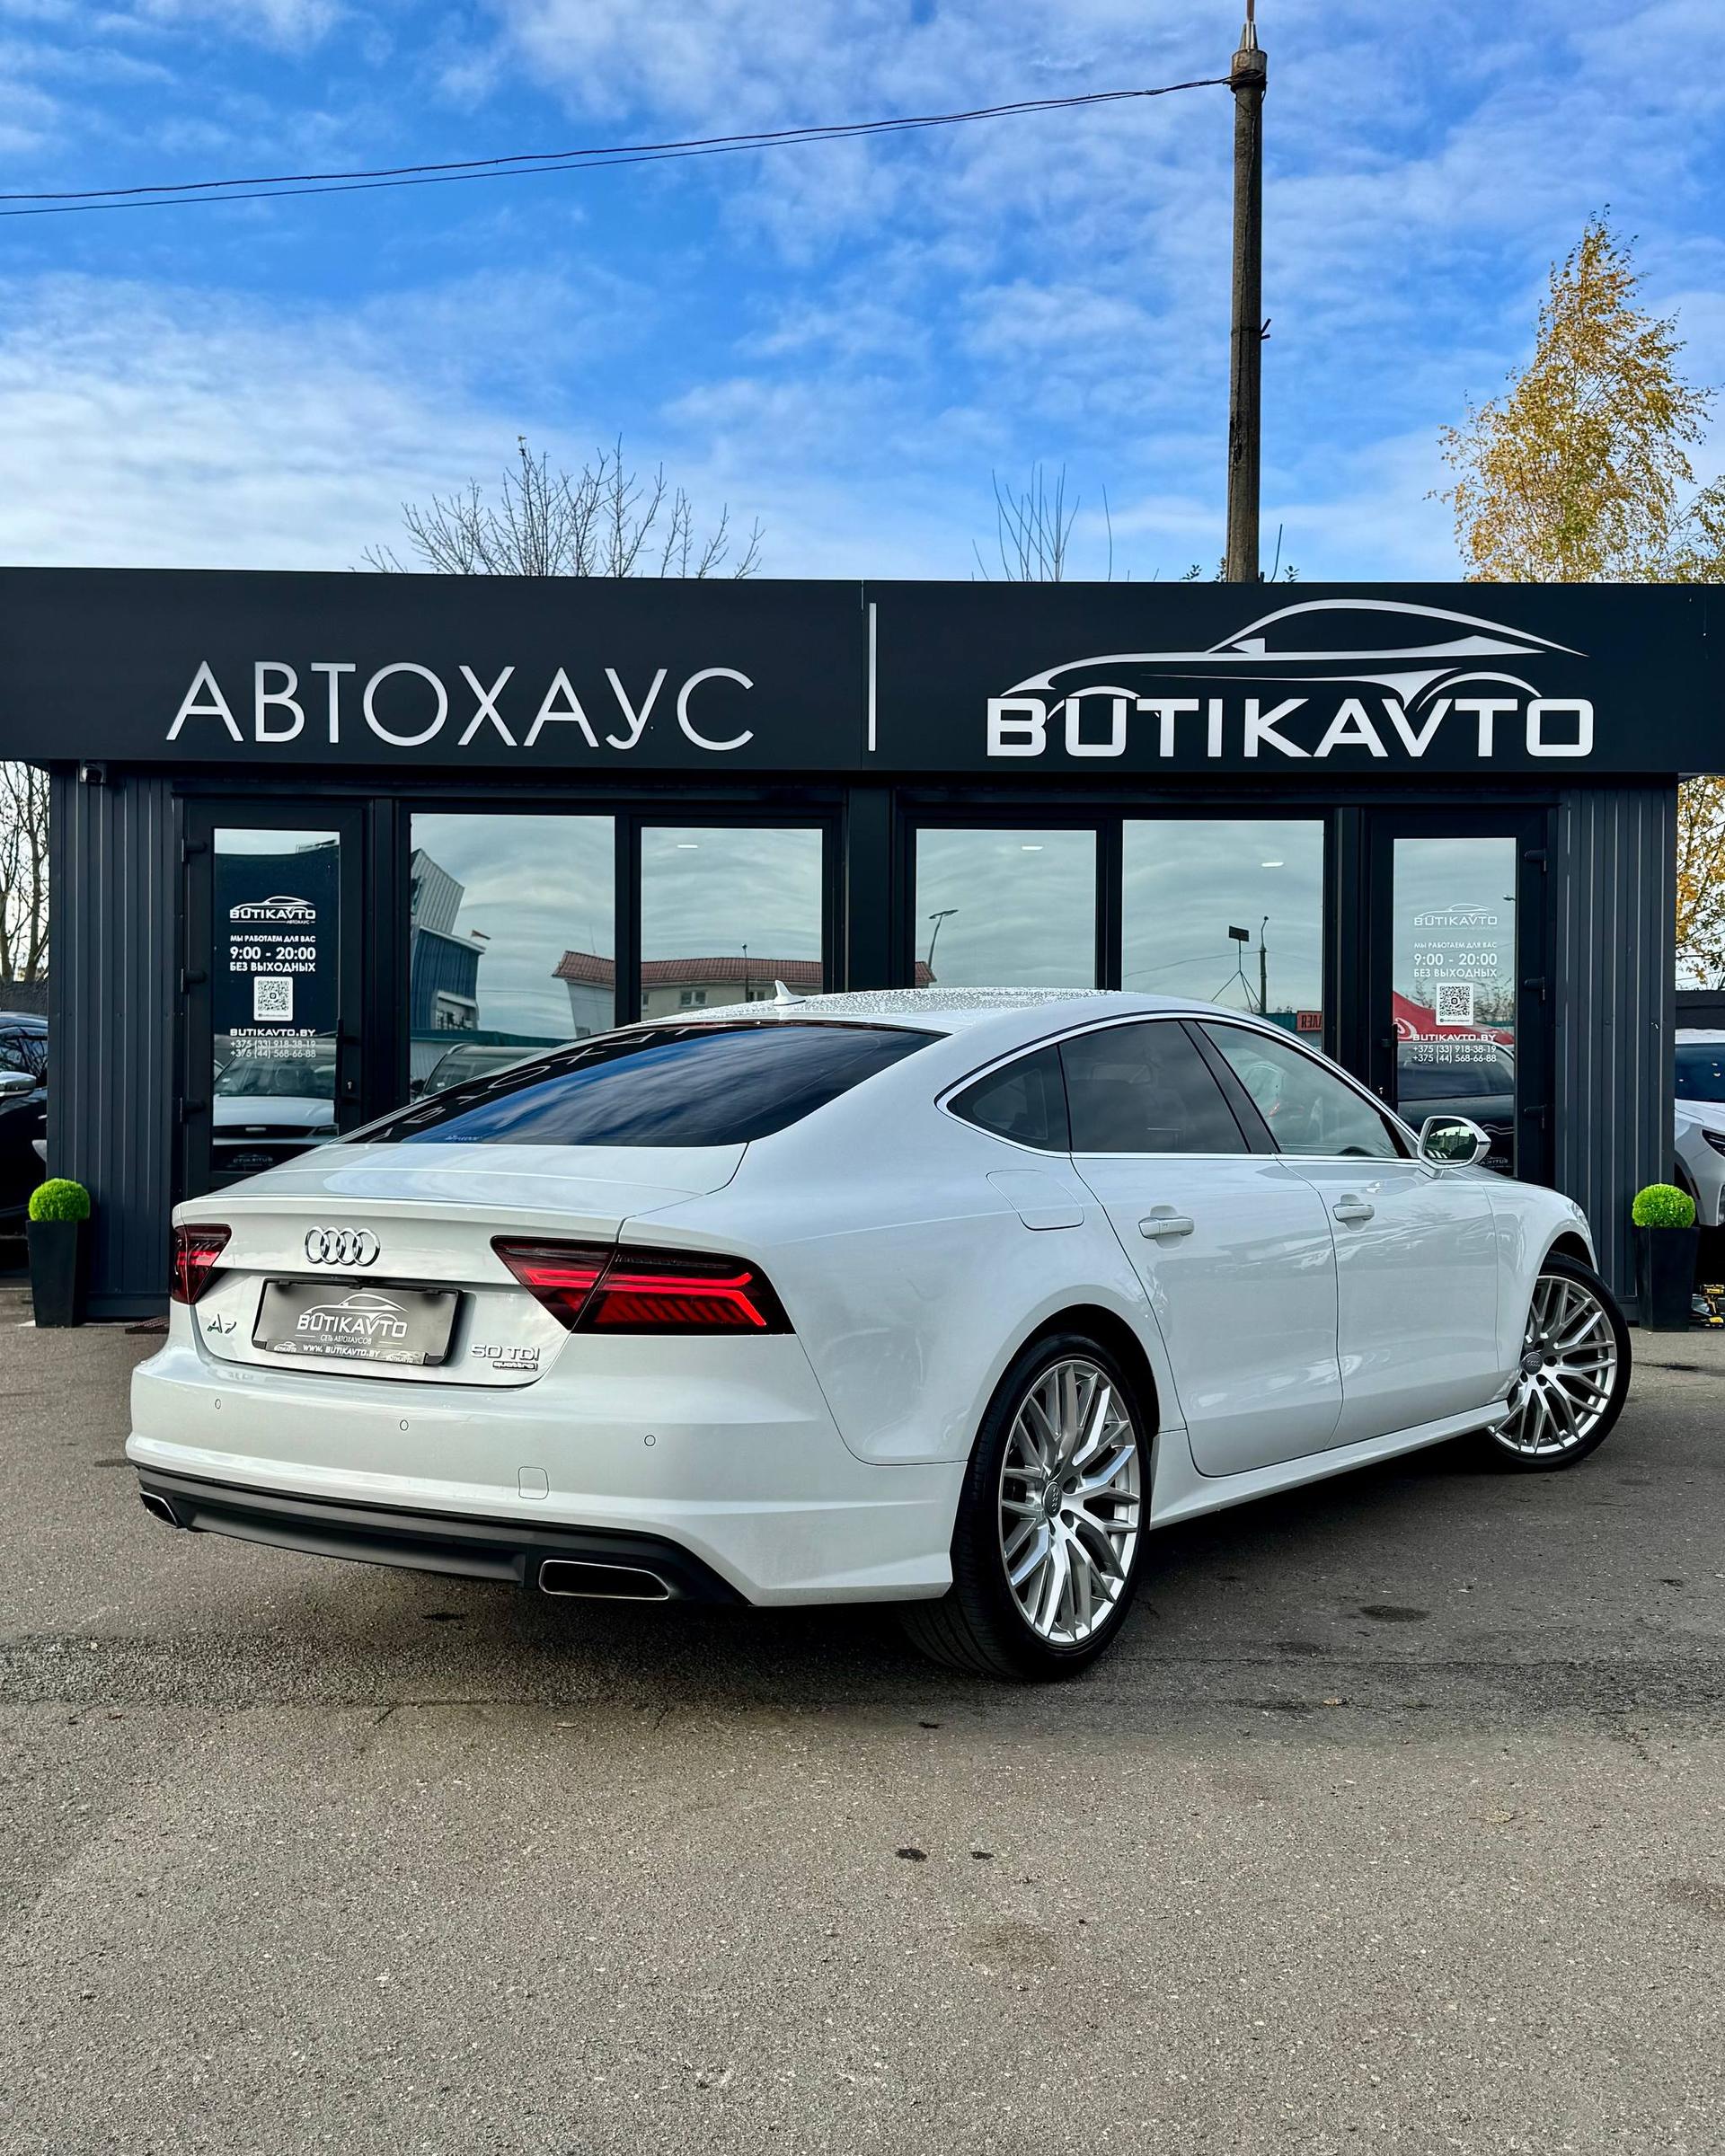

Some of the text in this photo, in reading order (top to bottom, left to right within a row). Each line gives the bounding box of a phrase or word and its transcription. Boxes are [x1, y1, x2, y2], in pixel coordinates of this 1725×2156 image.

[166, 660, 755, 751] АВТОХАУС
[986, 697, 1594, 757] BUTIKAVTO
[230, 909, 316, 919] BUTIKAVTO
[1413, 915, 1498, 926] BUTIKAVTO
[230, 946, 261, 960] 9:00
[275, 947, 316, 960] 20:00
[1414, 953, 1444, 966] 9:00
[1458, 953, 1498, 966] 20:00
[230, 962, 316, 973] БЕЗ ВЫХОДНЫХ
[1413, 968, 1497, 978] БЕЗ ВЫХОДНЫХ
[230, 1029, 316, 1037] BUTIKAVTO.BY
[1413, 1045, 1497, 1055] +375 (33) 918-38-19
[1412, 1054, 1497, 1064] +375 (44) 568-66-88
[207, 1313, 237, 1334] A7
[296, 1314, 408, 1338] BUTIKAVTO
[325, 1346, 381, 1358] BUTIKAVTO.BY
[471, 1344, 541, 1361] 50 TDI
[492, 1361, 536, 1370] quattro
